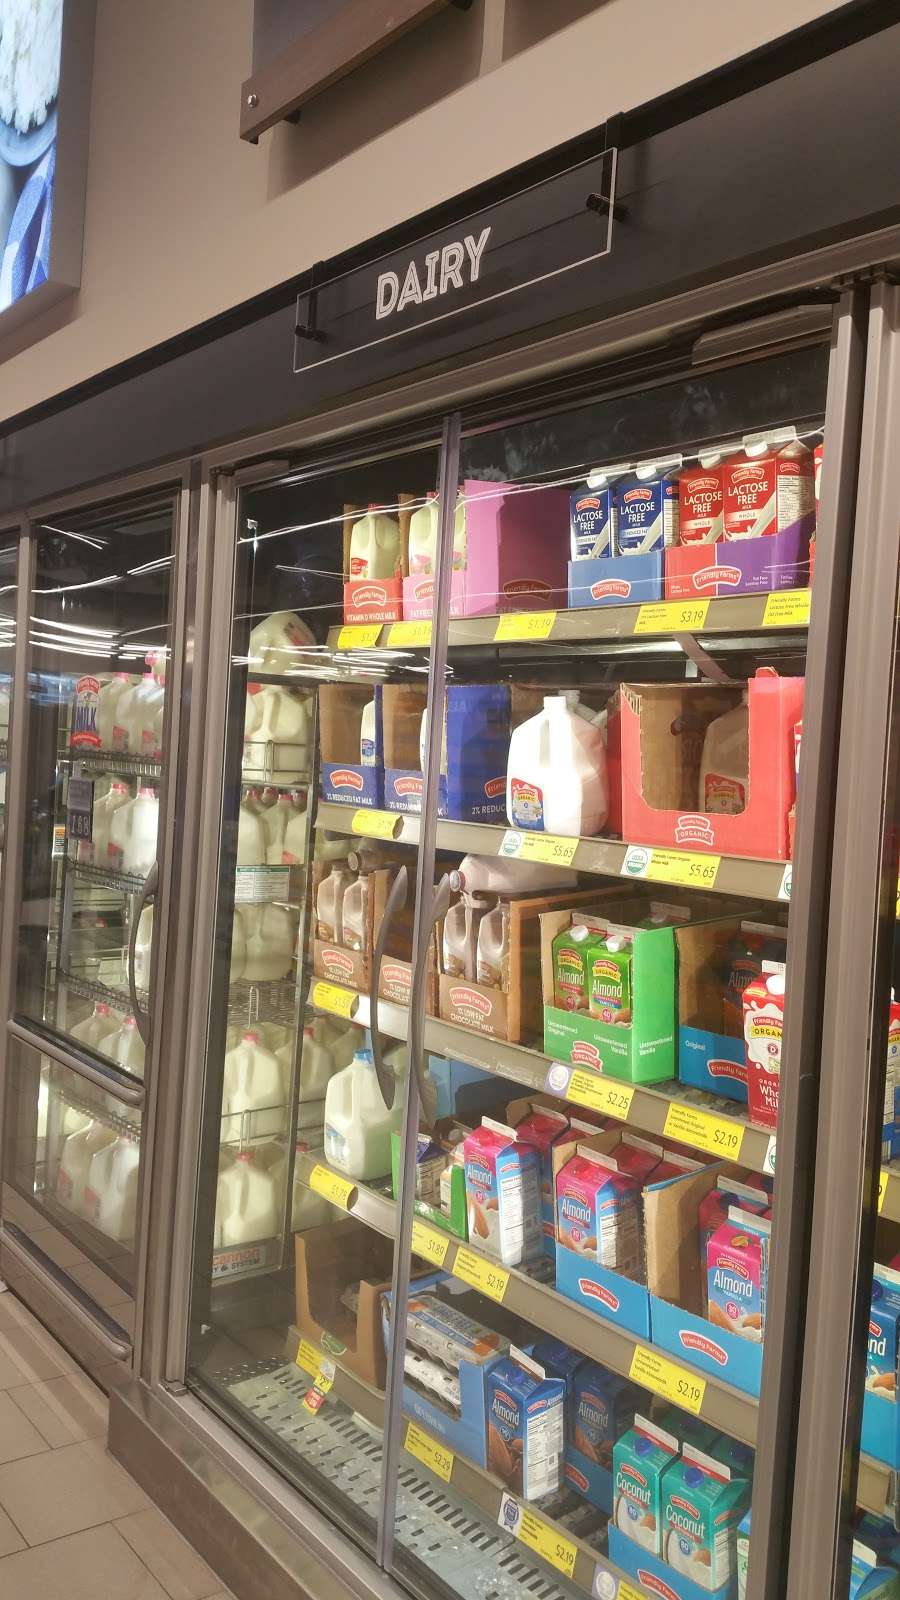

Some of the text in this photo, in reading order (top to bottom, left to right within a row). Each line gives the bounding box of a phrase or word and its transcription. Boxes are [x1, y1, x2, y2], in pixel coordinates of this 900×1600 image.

[375, 227, 491, 320] DAIRY
[728, 481, 768, 497] LACTOSE
[684, 491, 722, 506] LACTOSE
[737, 494, 757, 505] FREE
[620, 501, 655, 515] LACTOSE
[693, 503, 711, 513] FREE
[573, 510, 603, 523] LACTOSE
[628, 513, 645, 523] FREE
[580, 521, 594, 530] FREE
[696, 570, 719, 584] Friendly
[385, 611, 396, 620] MILK
[680, 610, 704, 624] $3.19
[76, 706, 97, 732] MILK
[332, 794, 352, 803] REDUCED
[472, 804, 506, 815] 2% REDUC
[680, 831, 708, 839] ORGANIC
[553, 845, 573, 858] $5.65
[689, 864, 715, 879] $5.65
[560, 958, 580, 968] ORGANIC
[558, 968, 584, 985] Almond
[596, 970, 617, 979] ORGANIC
[728, 971, 753, 989] Almo
[383, 988, 409, 1003] CHOCOLAT
[592, 980, 622, 997] Almond
[450, 1013, 494, 1034] CHOCOLATE MILK
[547, 1019, 578, 1034] Unsweetened
[754, 1017, 774, 1026] Friendly
[754, 1028, 782, 1038] ORGAN
[593, 1034, 628, 1049] Unsweetened
[640, 1035, 673, 1049] Unsweetened
[685, 1040, 706, 1051] Original
[611, 1045, 628, 1056] Vanilla
[574, 1053, 598, 1065] ORGANIC
[711, 1064, 748, 1080] Friendly Farm
[759, 1083, 780, 1098] Who
[606, 1091, 629, 1109] $2.25
[765, 1096, 779, 1108] Mil
[713, 1130, 738, 1148] $2.19
[467, 1164, 492, 1185] Almond
[561, 1199, 591, 1222] Almond
[428, 1239, 445, 1256] $1.89
[718, 1259, 747, 1276] Friendly Farms
[487, 1273, 504, 1291] $2.19
[713, 1270, 753, 1297] Almond
[723, 1290, 742, 1301] VANILLA
[728, 1304, 736, 1313] 30
[683, 1335, 726, 1360] Friendly Farms
[677, 1379, 701, 1401] $2.19
[491, 1399, 520, 1427] Almond
[578, 1402, 608, 1429] Almond
[616, 1472, 651, 1505] Coconut
[666, 1504, 705, 1539] Coconut
[681, 1540, 689, 1551] 80
[555, 1543, 574, 1566] $2.19
